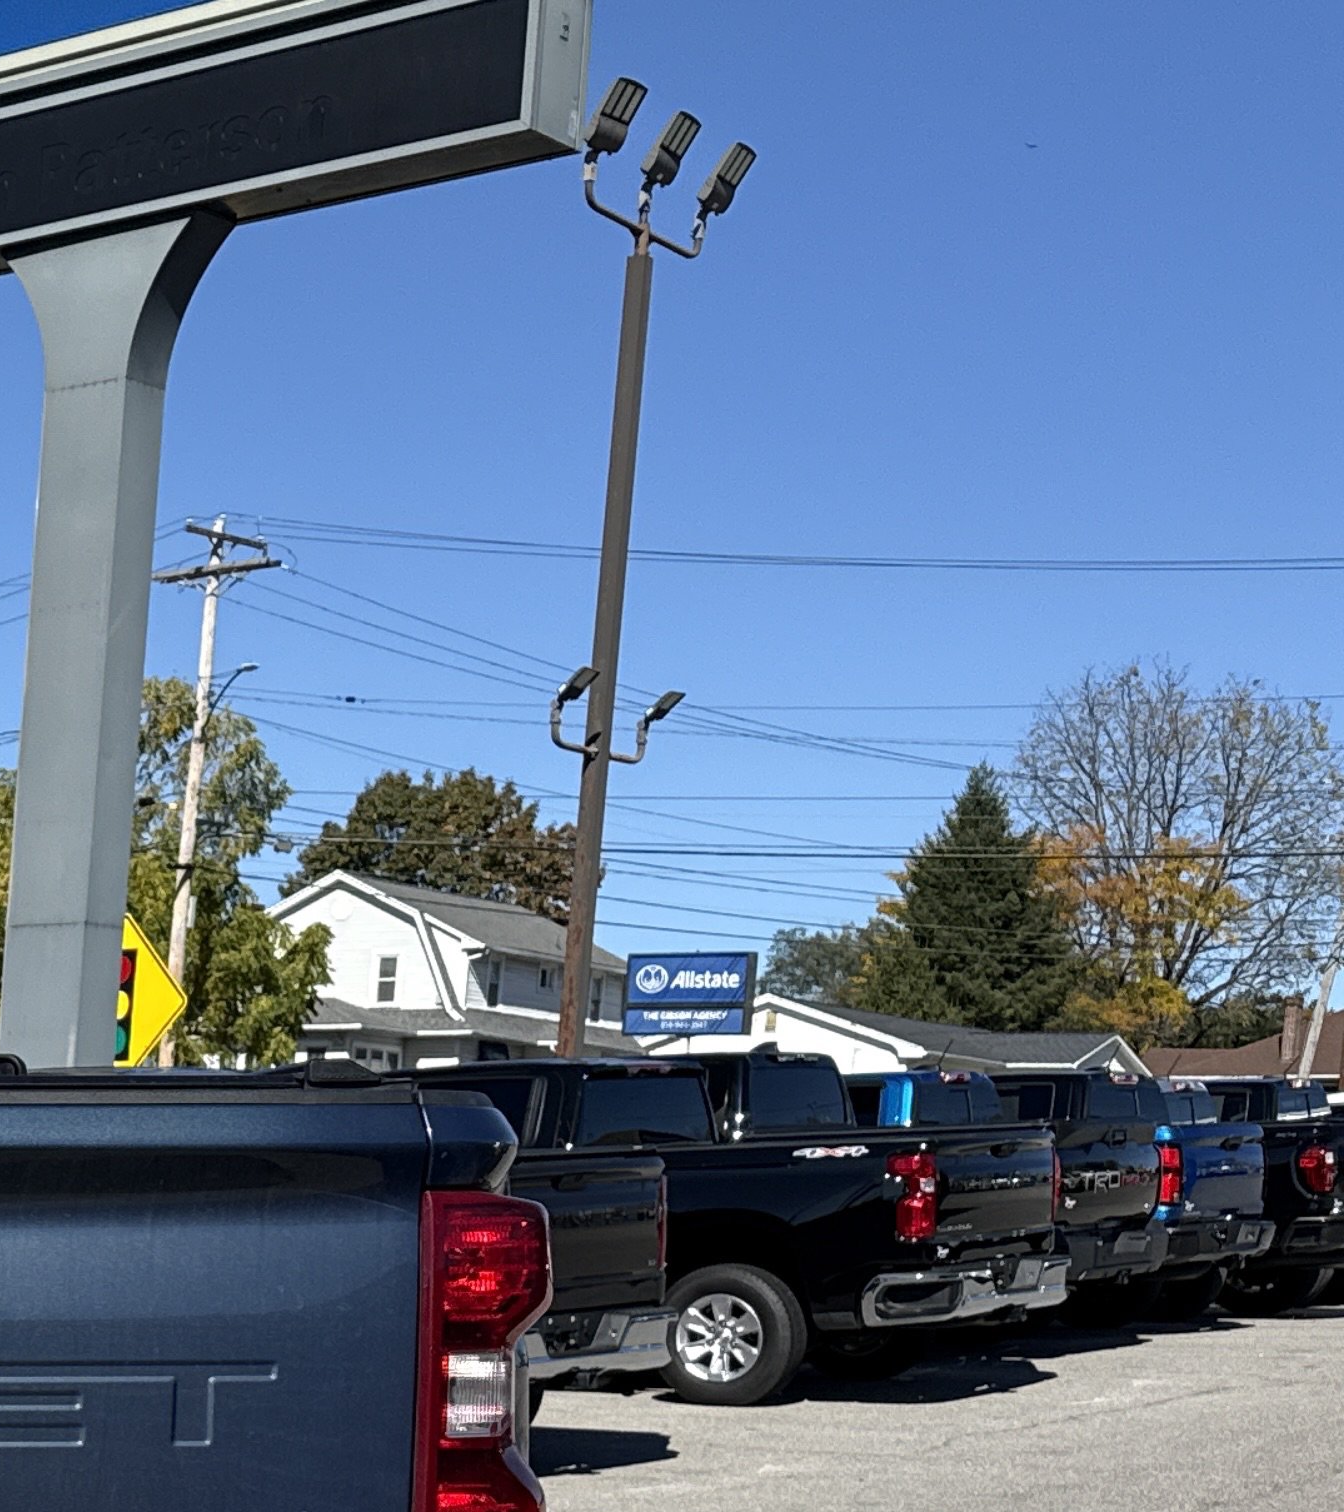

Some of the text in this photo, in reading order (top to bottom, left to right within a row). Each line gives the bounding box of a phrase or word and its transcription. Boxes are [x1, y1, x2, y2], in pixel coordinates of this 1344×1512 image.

[39, 94, 334, 200] Patterson
[670, 970, 740, 988] Allstate
[1080, 1170, 1120, 1193] TRD
